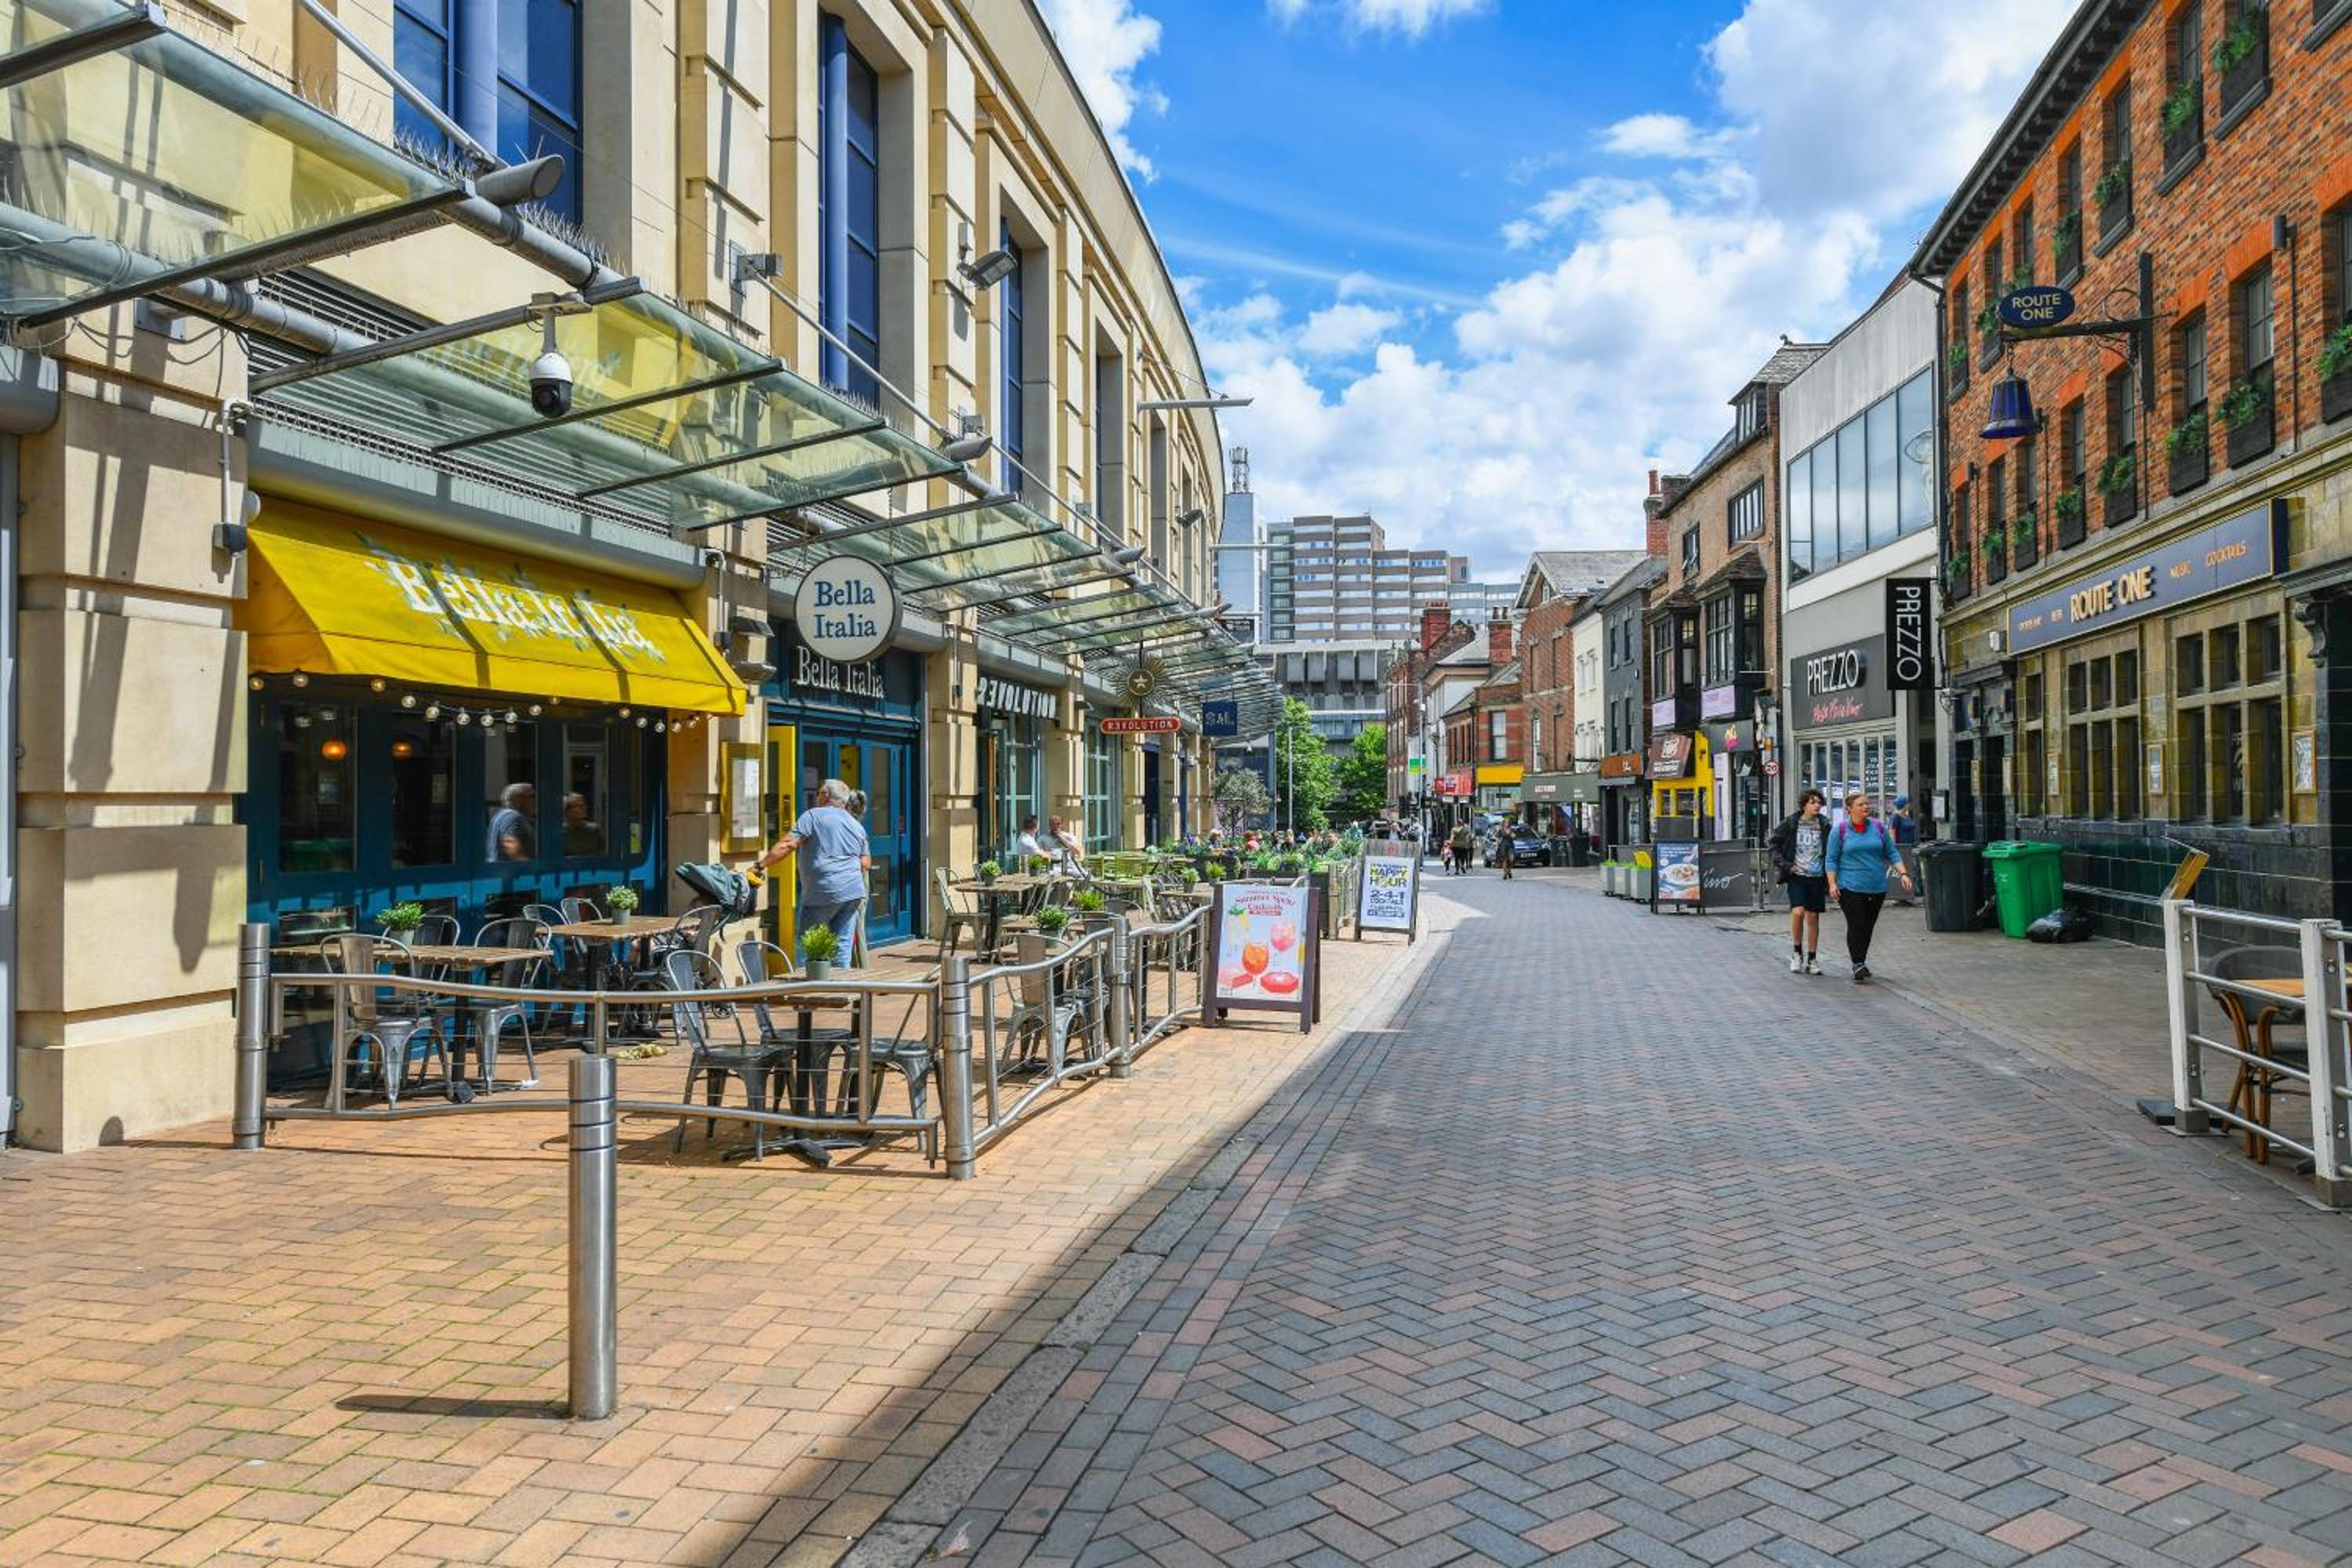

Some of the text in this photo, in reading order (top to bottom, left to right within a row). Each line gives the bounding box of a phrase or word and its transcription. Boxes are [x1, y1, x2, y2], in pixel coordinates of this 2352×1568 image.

[2013, 293, 2061, 308] ROUTE
[2020, 307, 2054, 321] ONE
[814, 579, 876, 607] Bella
[2070, 579, 2115, 624] ROUTE
[2117, 565, 2154, 605] ONE
[813, 612, 877, 638] Italia
[1896, 586, 1922, 681] PREZZO
[792, 645, 884, 699] Bella Italia
[1806, 649, 1859, 698] PREZZO
[1370, 868, 1408, 877] HAPPY
[1370, 877, 1407, 887] HOUR
[1370, 889, 1405, 899] 2-4-1
